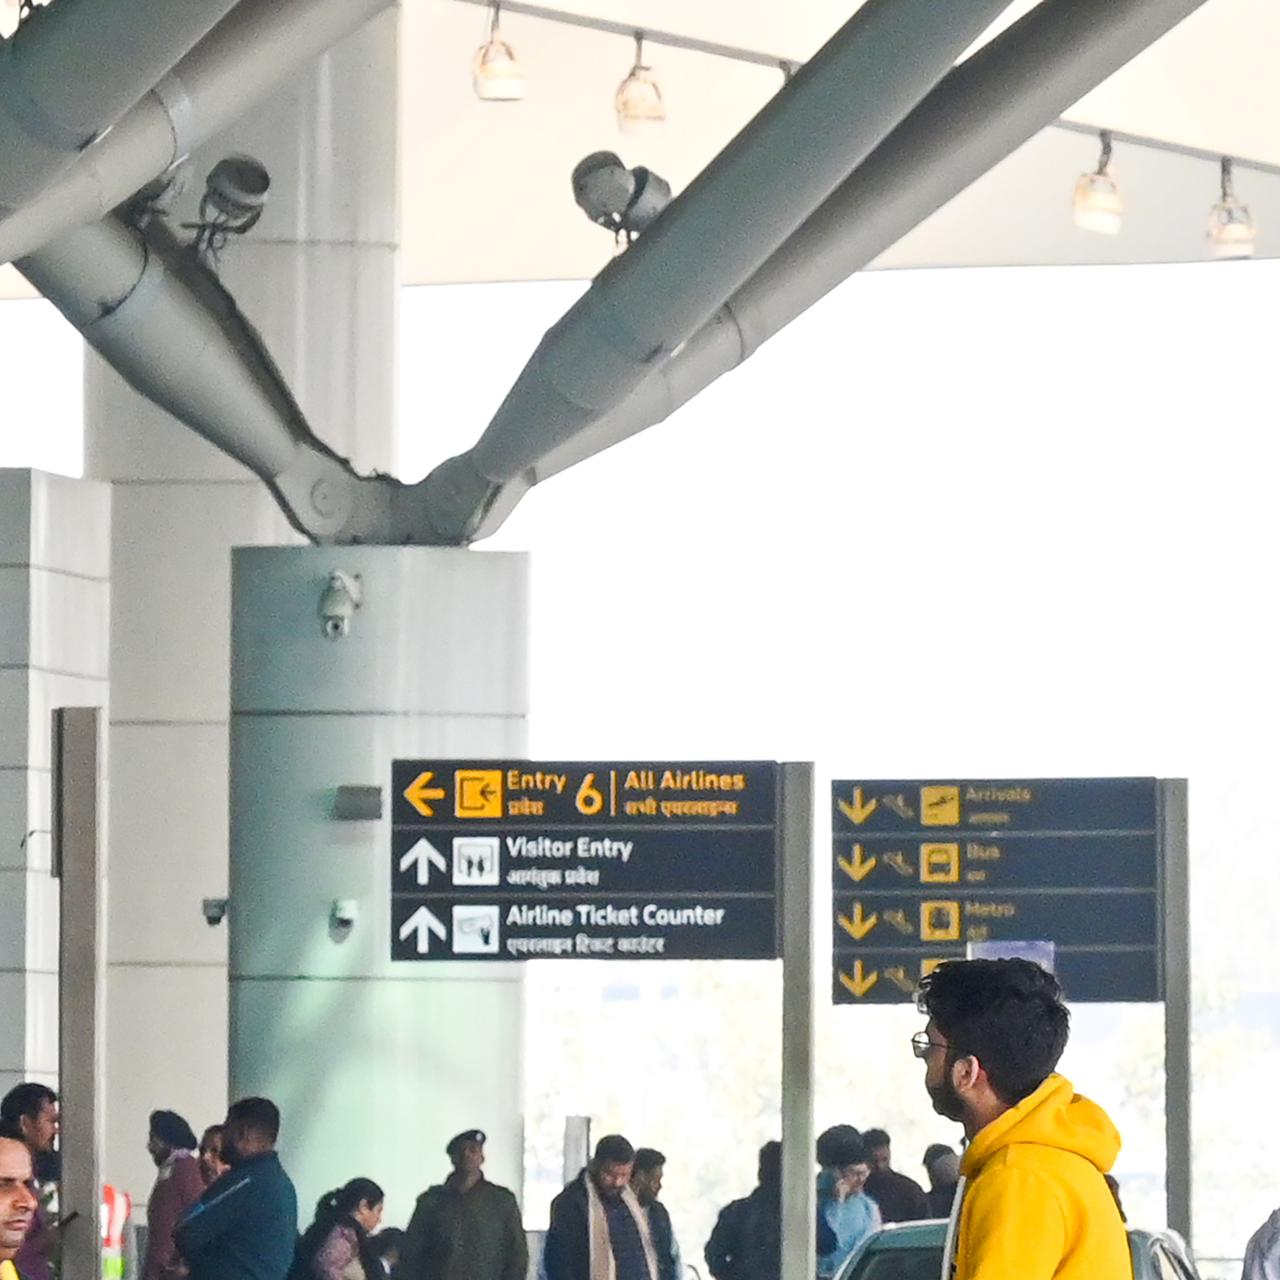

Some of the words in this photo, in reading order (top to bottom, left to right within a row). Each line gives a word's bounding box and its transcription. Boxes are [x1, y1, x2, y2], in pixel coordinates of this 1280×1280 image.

[507, 769, 567, 794] Entry
[575, 772, 603, 815] 6
[624, 769, 656, 790] All
[660, 769, 745, 790] Airlines
[506, 836, 574, 857] Visitor
[577, 837, 633, 863] Entry
[506, 904, 573, 926] Airline
[576, 904, 638, 926] Ticket
[643, 904, 725, 926] Counter
